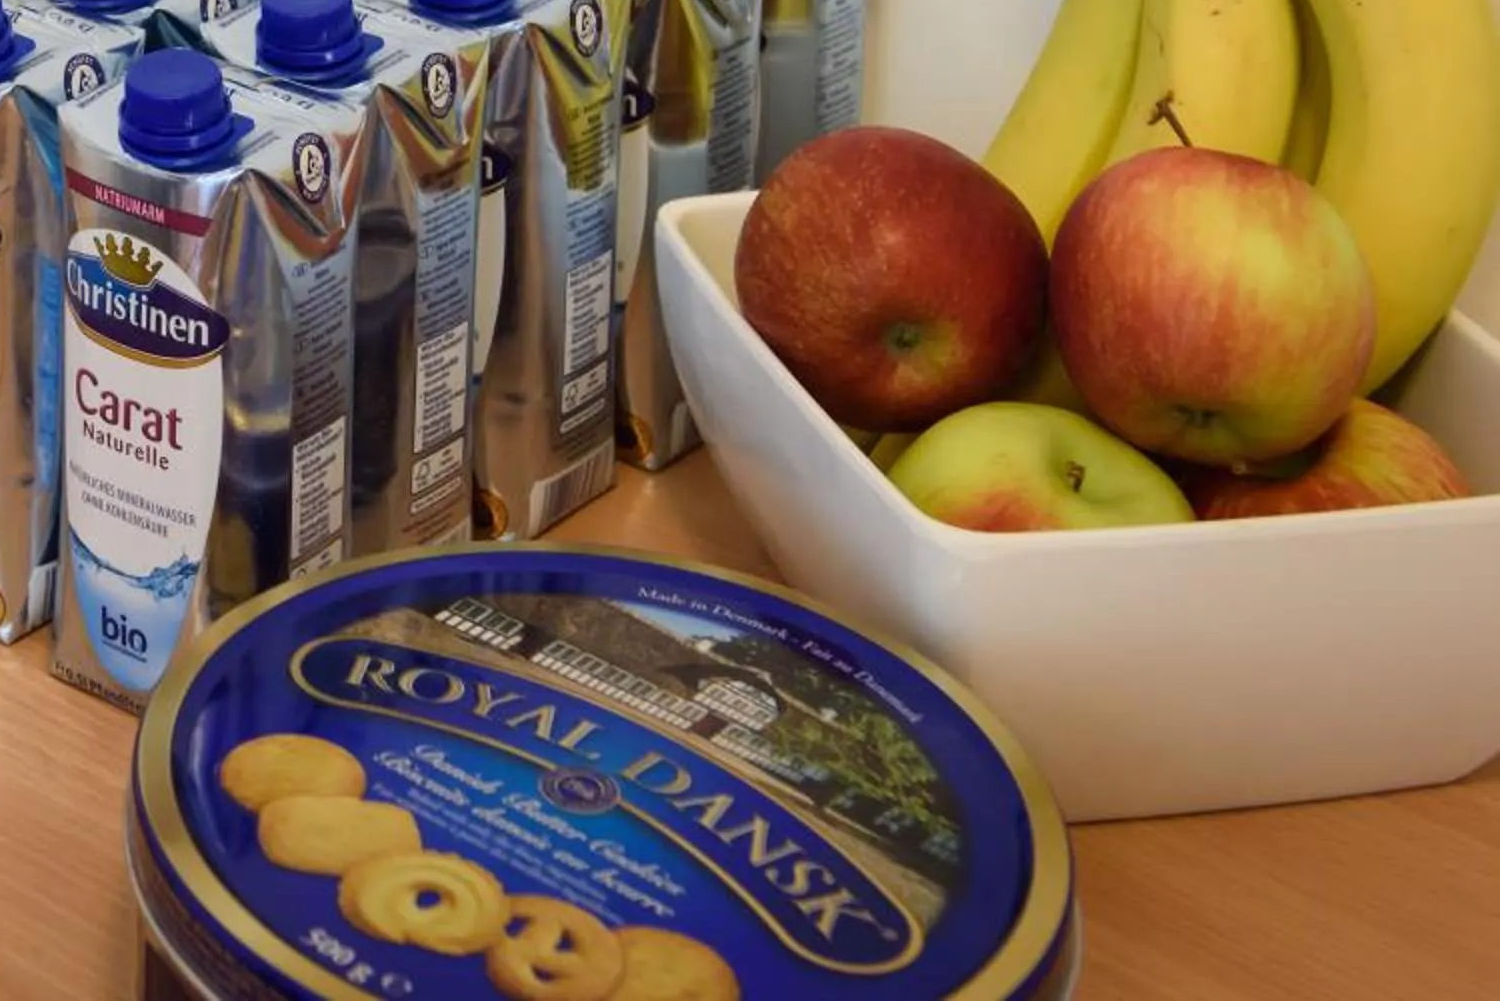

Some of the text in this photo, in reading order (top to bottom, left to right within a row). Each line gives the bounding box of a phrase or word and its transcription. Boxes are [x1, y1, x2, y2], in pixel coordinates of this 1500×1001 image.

[95, 184, 165, 224] NATRIUMARM
[67, 258, 209, 347] Christinen
[76, 368, 183, 451] Carat
[83, 419, 169, 470] Naturelle
[101, 606, 148, 655] bio
[638, 586, 686, 606] Made
[690, 600, 708, 612] in
[712, 604, 788, 640] Denmark
[345, 654, 605, 761] ROYAL
[620, 750, 885, 941] DANSK
[300, 928, 357, 966] 500
